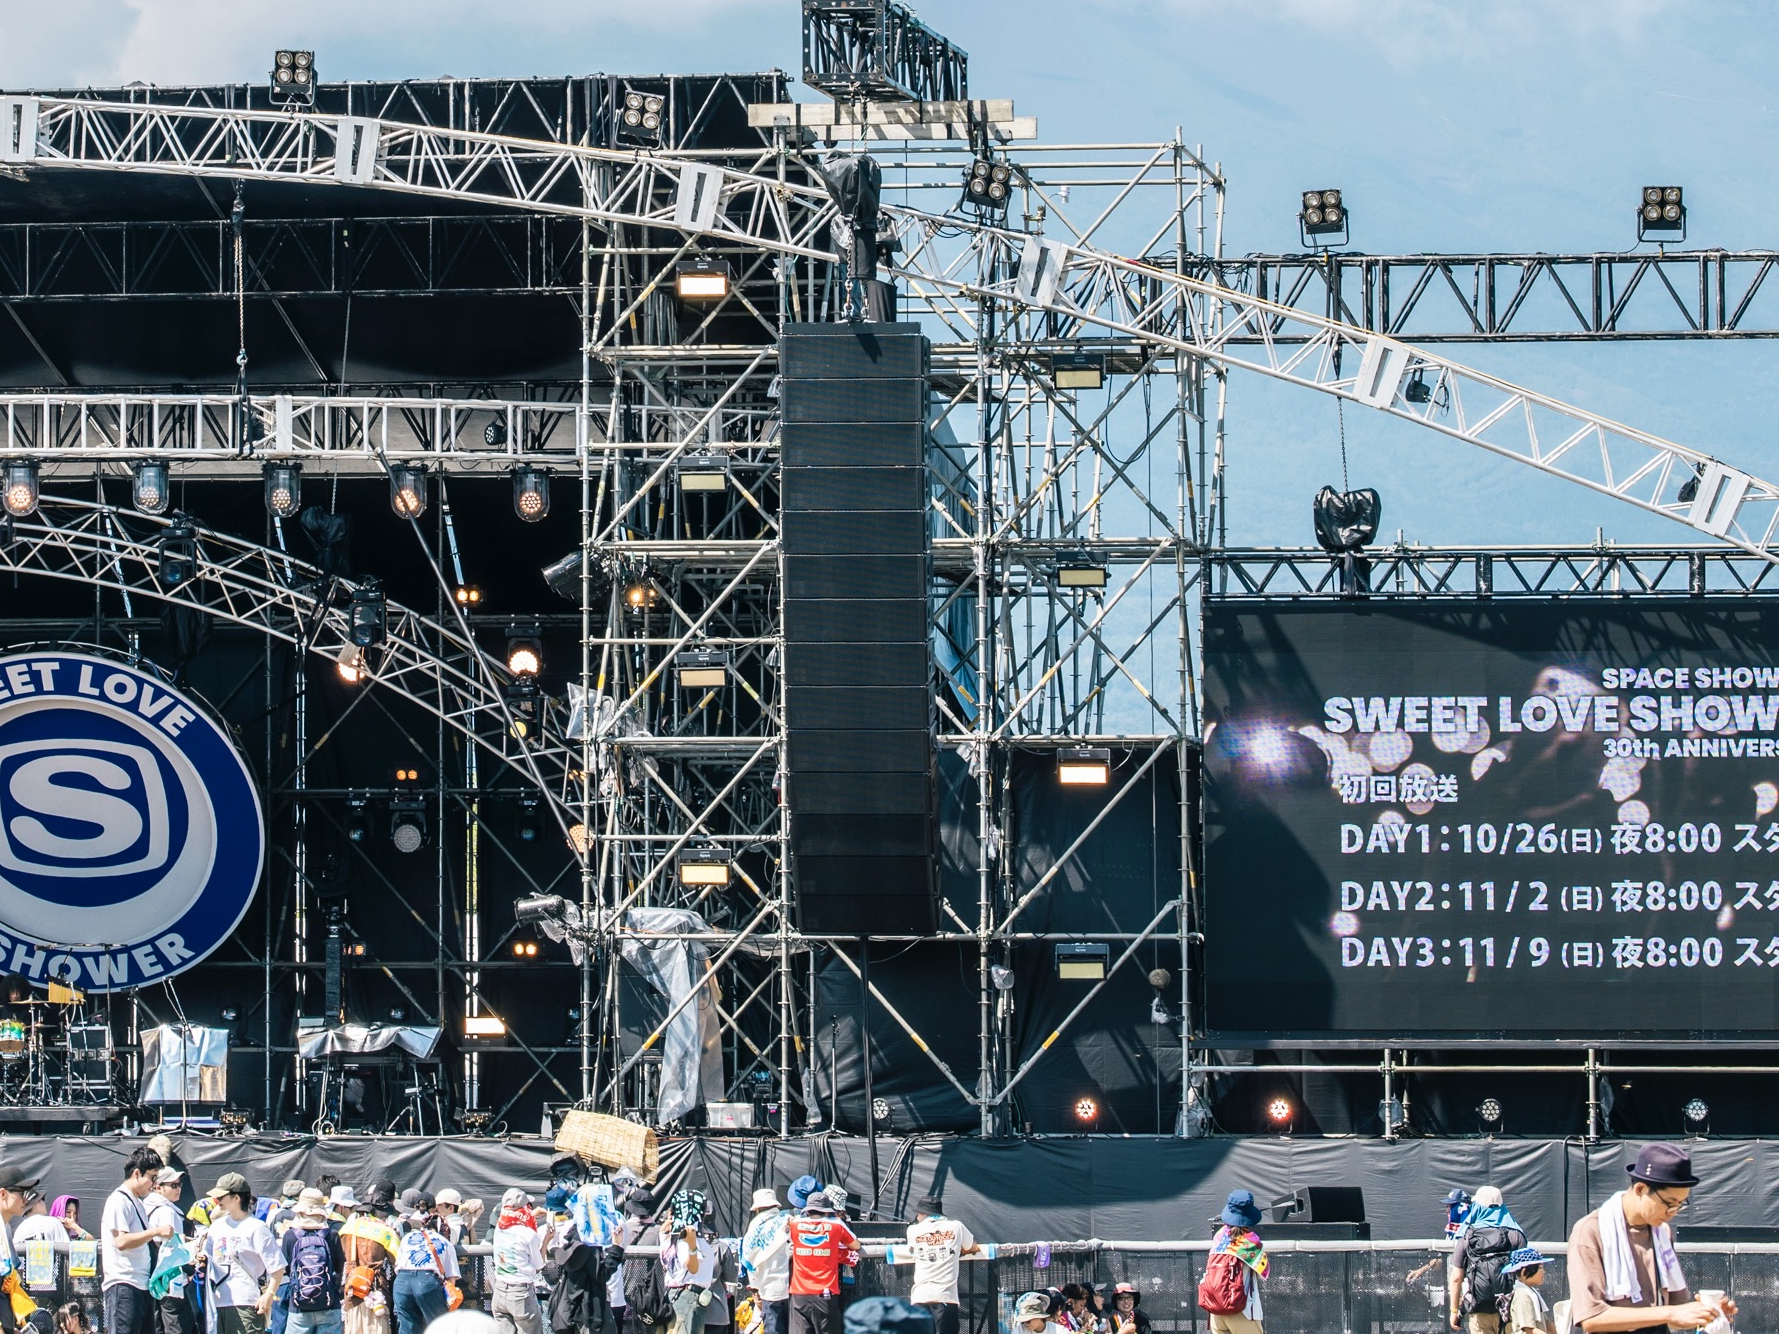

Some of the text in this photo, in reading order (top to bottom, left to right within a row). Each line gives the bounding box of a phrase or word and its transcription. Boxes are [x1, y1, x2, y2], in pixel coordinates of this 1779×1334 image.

[1602, 667, 1690, 689] SPACE
[78, 665, 196, 738] LOVE
[1324, 696, 1488, 733] SWEET
[1499, 695, 1620, 733] LOVE
[1603, 738, 1779, 758] 30th ANNIVER
[1339, 774, 1459, 804] 初回放送
